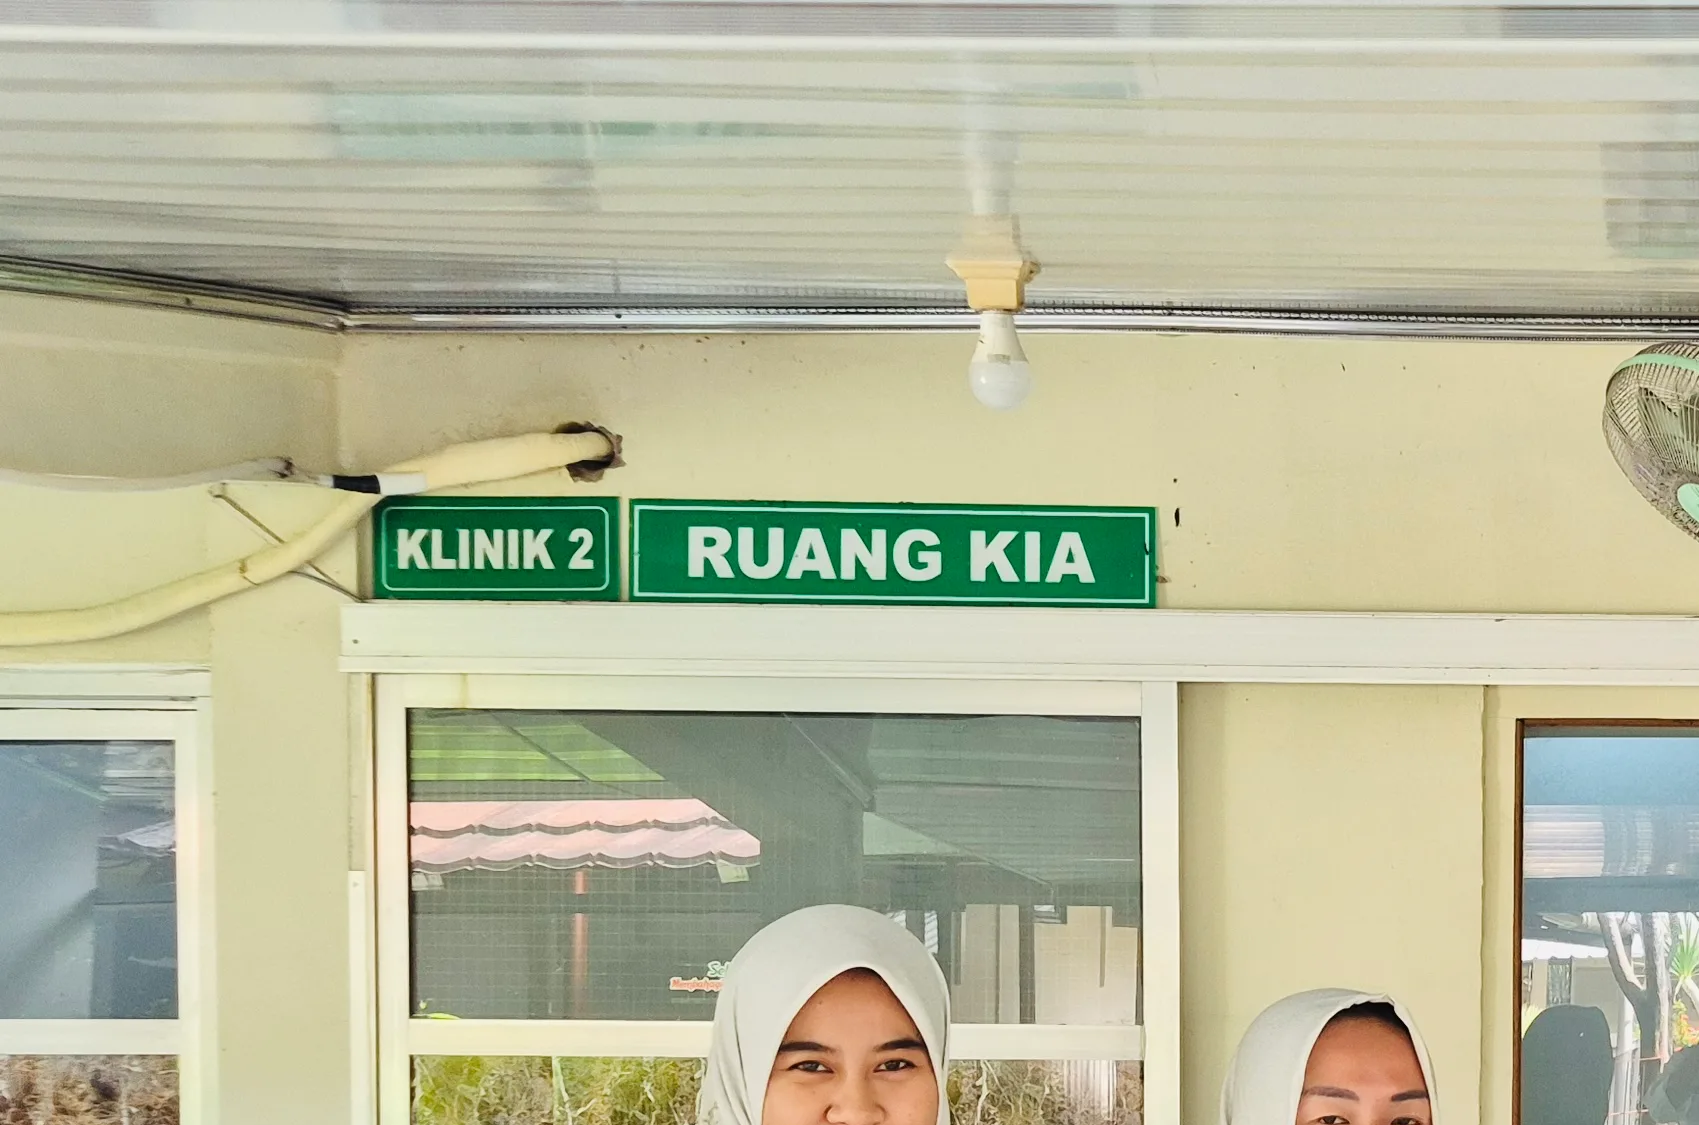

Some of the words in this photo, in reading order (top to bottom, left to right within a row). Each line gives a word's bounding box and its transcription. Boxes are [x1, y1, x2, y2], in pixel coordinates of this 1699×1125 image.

[396, 528, 555, 571] KLINIK
[568, 527, 595, 571] 2
[687, 525, 943, 581] RUANG
[968, 530, 1096, 584] KIA
